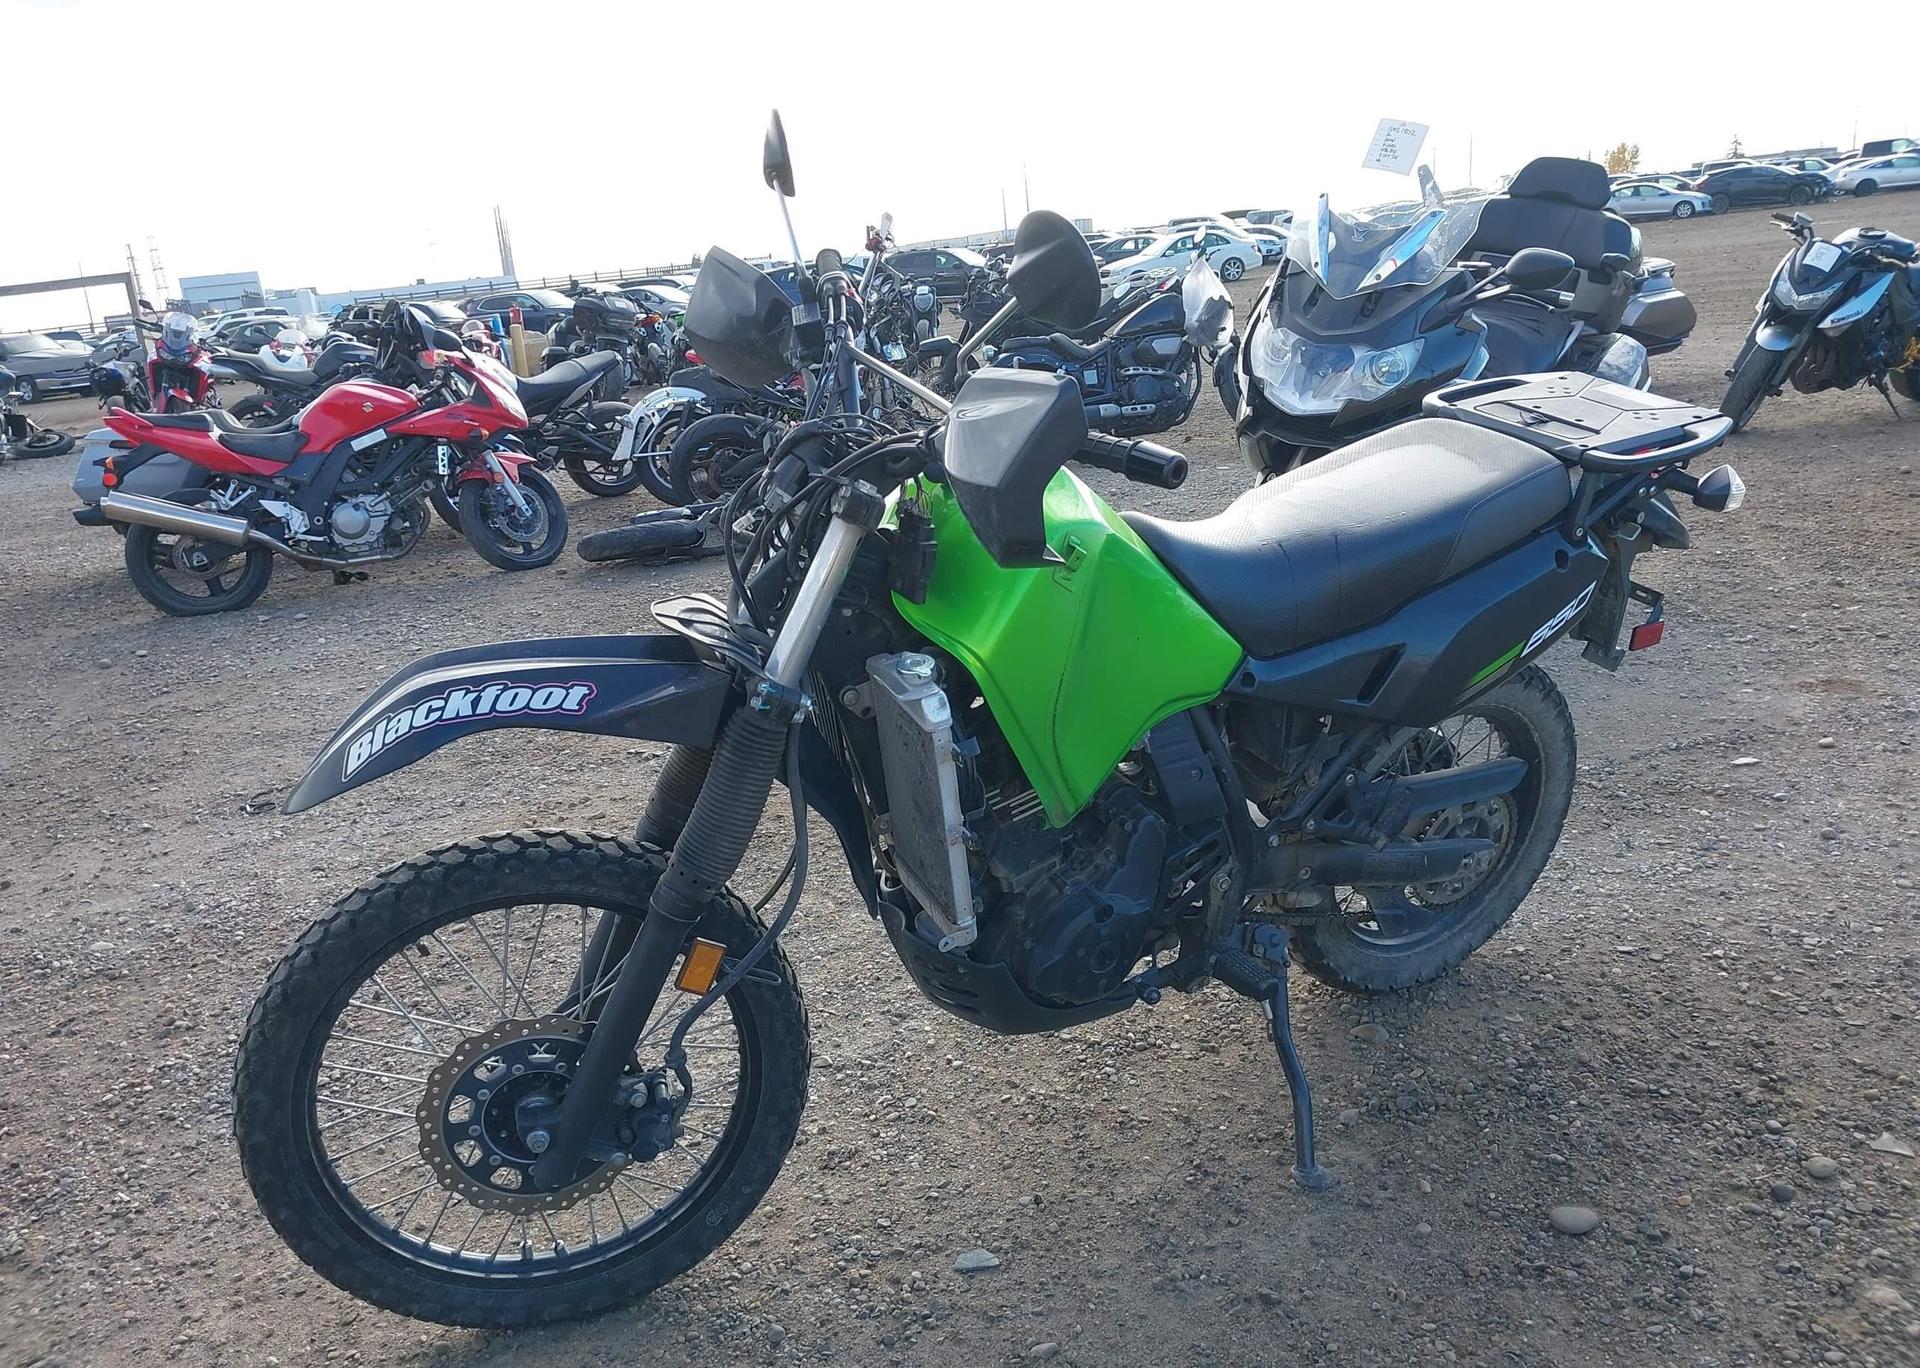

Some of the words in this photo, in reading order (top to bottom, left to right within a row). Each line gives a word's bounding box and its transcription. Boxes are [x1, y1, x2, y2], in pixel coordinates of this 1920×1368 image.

[1830, 309, 1864, 325] Kawasaki
[1520, 580, 1597, 658] 650
[345, 684, 591, 776] Blackfoot
